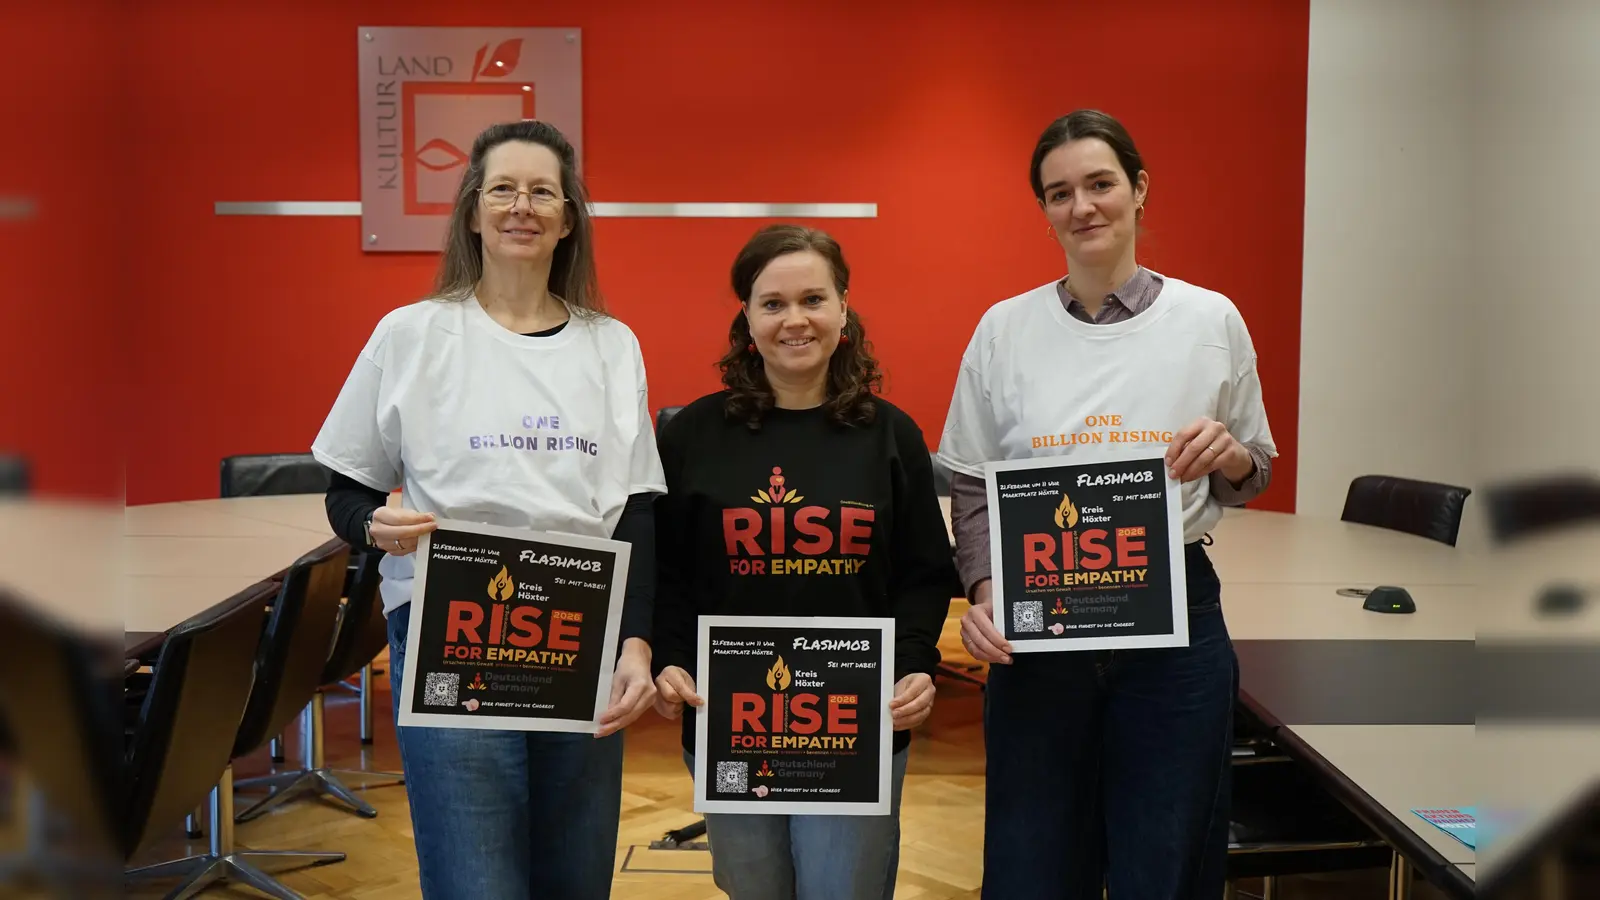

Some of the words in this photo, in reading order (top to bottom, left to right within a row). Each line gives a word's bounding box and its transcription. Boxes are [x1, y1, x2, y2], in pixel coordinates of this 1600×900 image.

[378, 56, 453, 76] LAND
[376, 80, 397, 190] KULTUR
[522, 416, 560, 429] ONE
[1085, 414, 1122, 427] ONE
[546, 436, 598, 456] RISING
[1032, 432, 1104, 449] BILLION
[1108, 430, 1173, 443] RISING
[1076, 470, 1154, 488] FLASHMOB
[1112, 494, 1124, 502] SEI
[1082, 506, 1104, 514] Kreis
[1082, 515, 1112, 524] Höxter
[722, 505, 875, 556] RISE
[1118, 528, 1144, 537] 2026
[1023, 526, 1148, 572] RISE
[432, 553, 474, 562] MARKTPLATZ
[519, 550, 602, 572] FLASHMOB
[729, 559, 766, 576] FOR
[771, 558, 866, 575] EMPATHY
[554, 577, 566, 585] SEI
[567, 579, 582, 587] MIT
[1025, 574, 1060, 588] FOR
[1063, 568, 1148, 586] EMPATHY
[519, 582, 543, 592] Kreis
[518, 591, 550, 602] Höxter
[1064, 594, 1129, 605] Deutschland
[552, 611, 581, 621] 2026
[1072, 605, 1119, 615] Germany
[445, 600, 583, 651] RISE
[792, 636, 870, 652] FLASHMOB
[443, 645, 481, 660] FOR
[486, 648, 578, 666] EMPATHY
[827, 661, 839, 669] SEI
[485, 672, 553, 684] Deutschland
[795, 670, 818, 678] Kreis
[490, 682, 540, 695] Germany
[795, 679, 825, 688] Höxter
[731, 693, 859, 734] RISE
[731, 735, 768, 748] FOR
[771, 736, 857, 749] EMPATHY
[772, 759, 836, 769] Deutschland
[778, 769, 826, 780] Germany
